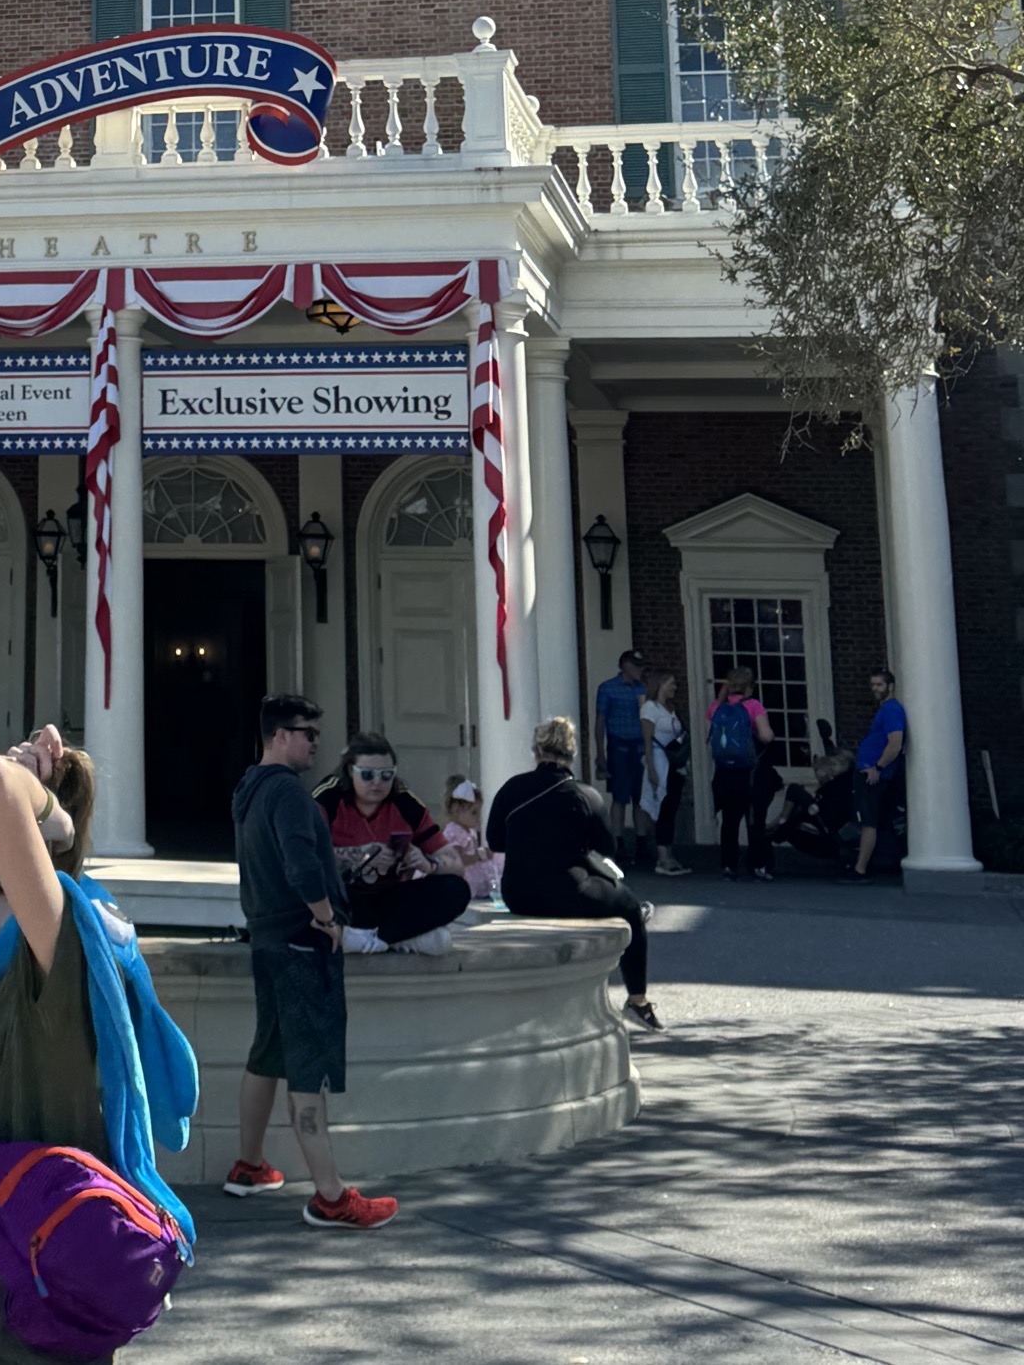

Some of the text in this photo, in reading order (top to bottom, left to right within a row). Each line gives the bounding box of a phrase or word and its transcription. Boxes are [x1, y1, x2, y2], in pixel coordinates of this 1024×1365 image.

[9, 43, 272, 129] ADVENTURE
[21, 385, 72, 400] Event
[158, 385, 452, 420] Exclusive Showing
